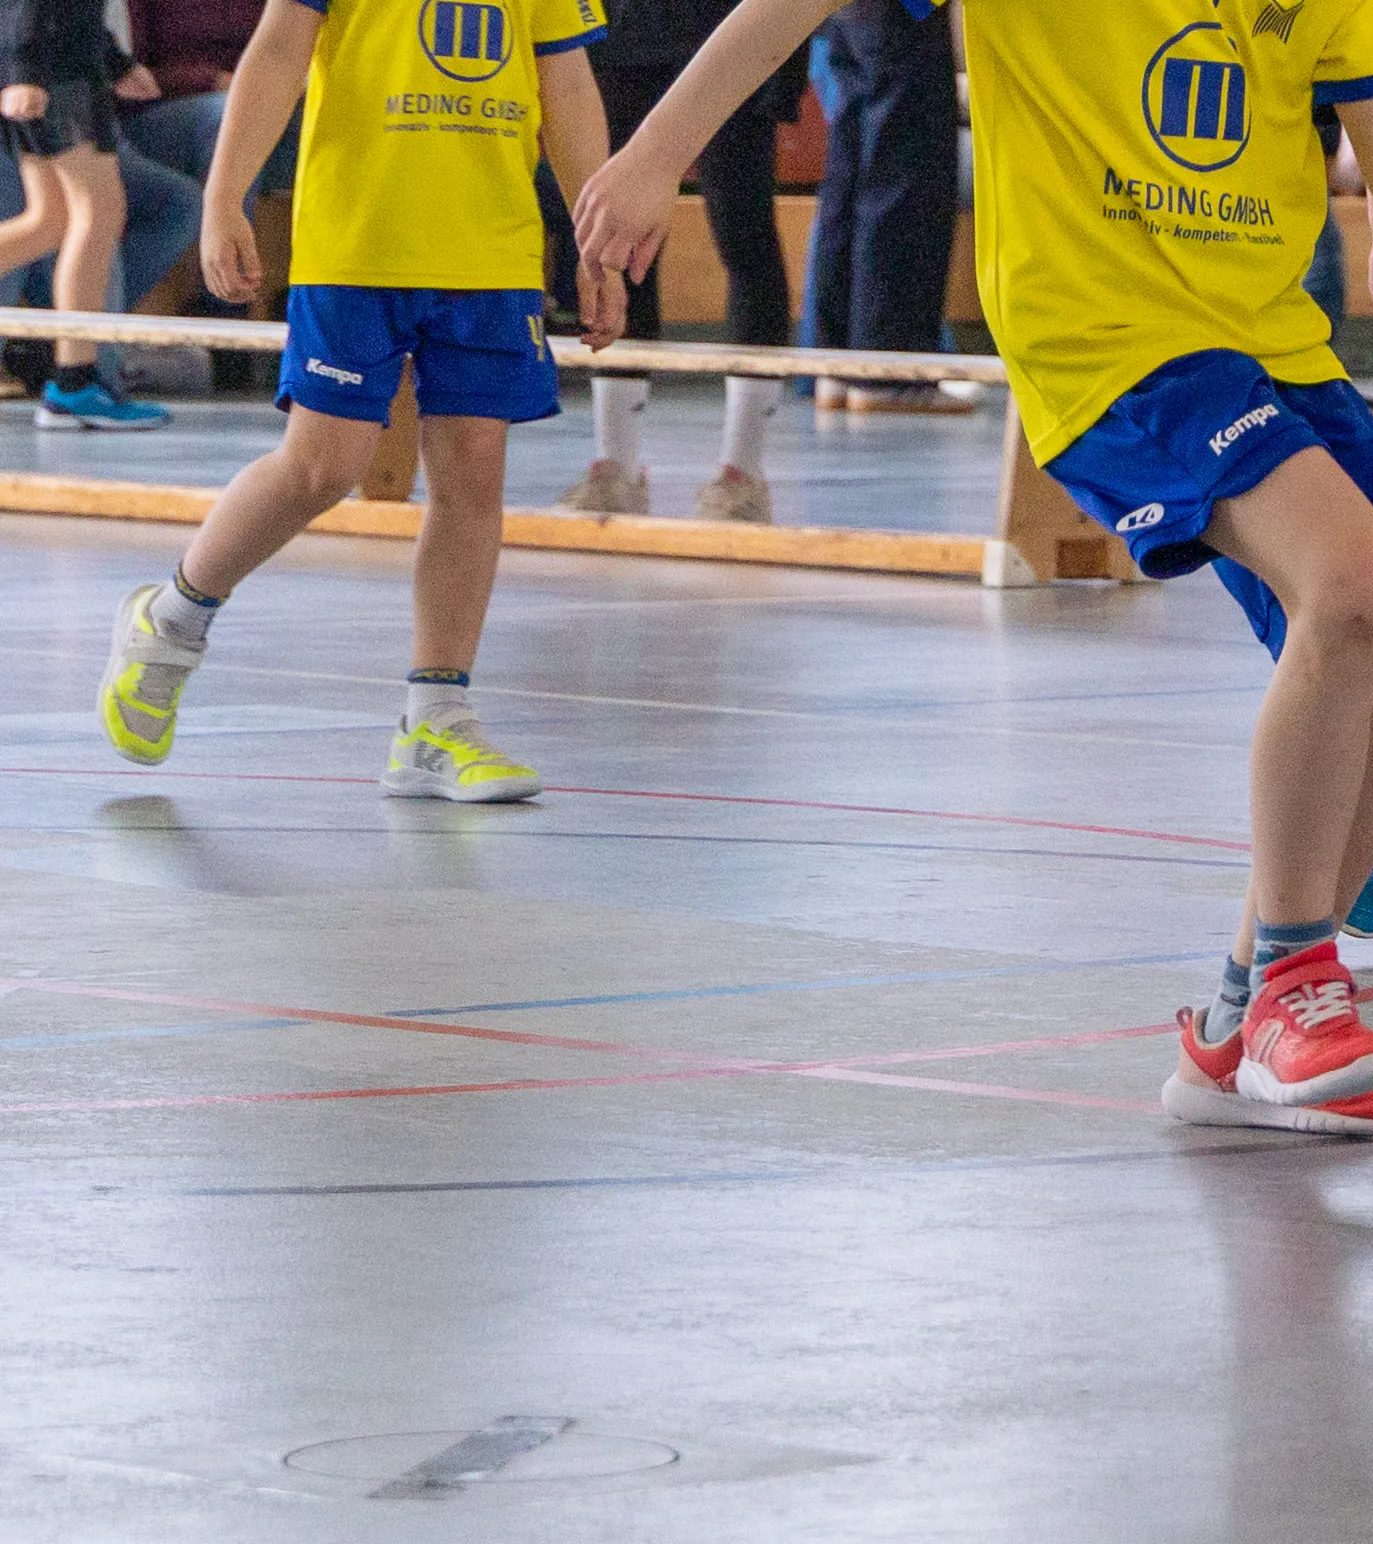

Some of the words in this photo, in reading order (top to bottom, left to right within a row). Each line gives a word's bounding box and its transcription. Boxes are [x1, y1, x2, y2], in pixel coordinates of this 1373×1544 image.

[385, 93, 473, 116] MEDING
[1217, 191, 1275, 226] GMBH
[305, 357, 365, 385] Kempa
[1208, 403, 1280, 457] Kempa
